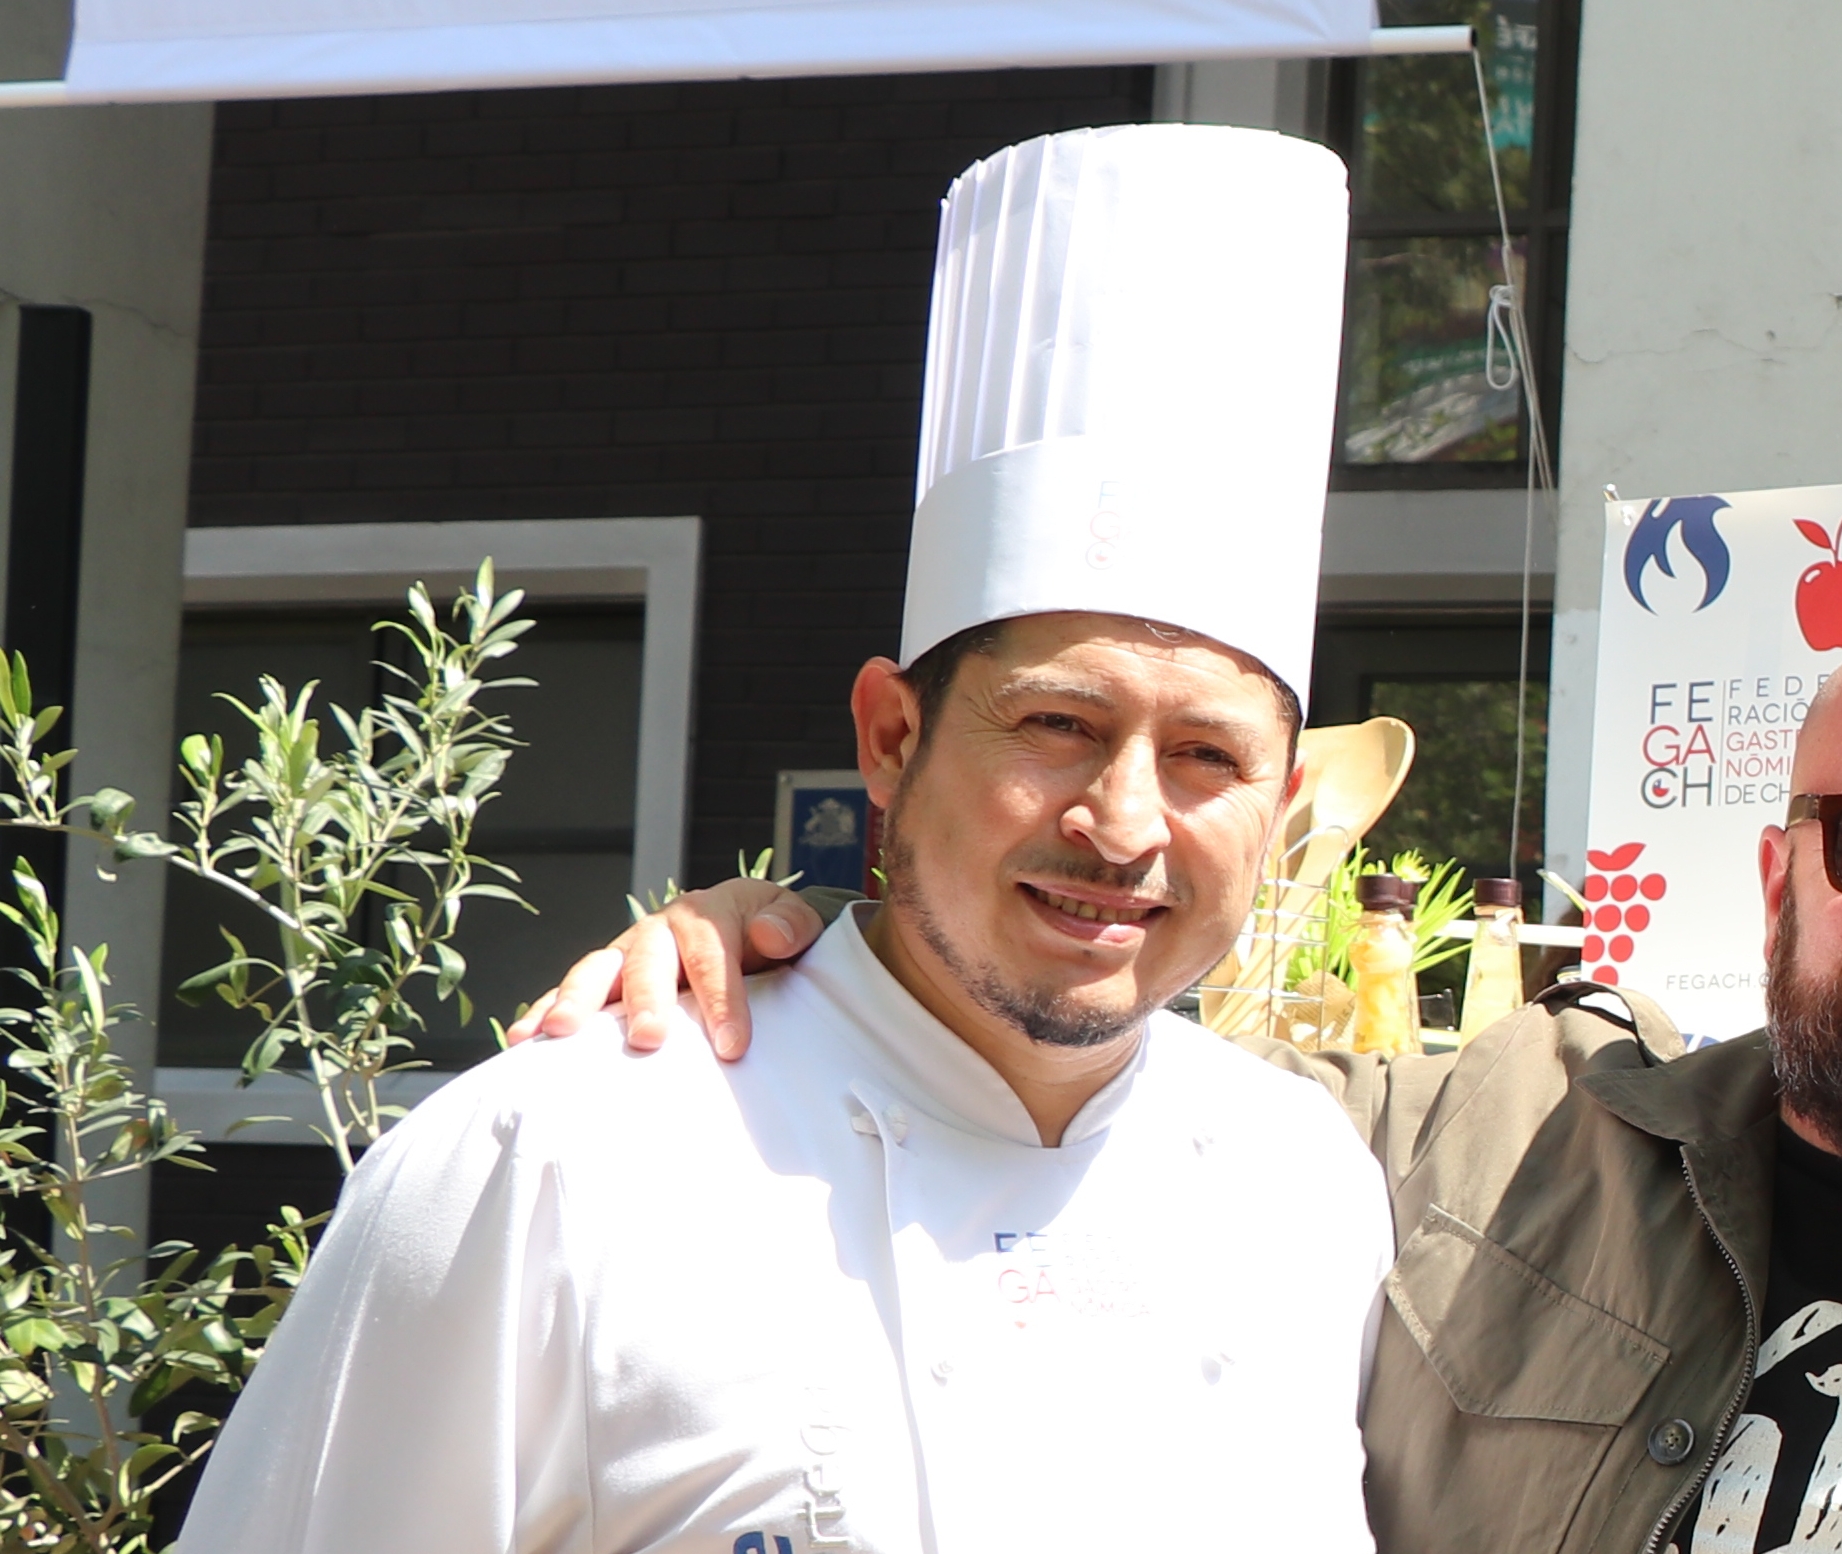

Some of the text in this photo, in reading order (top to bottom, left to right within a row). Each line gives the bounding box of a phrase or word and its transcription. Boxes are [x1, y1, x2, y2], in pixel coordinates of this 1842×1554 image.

[1650, 680, 1715, 725] FE
[1642, 724, 1716, 767] GA
[1641, 764, 1713, 810] CH
